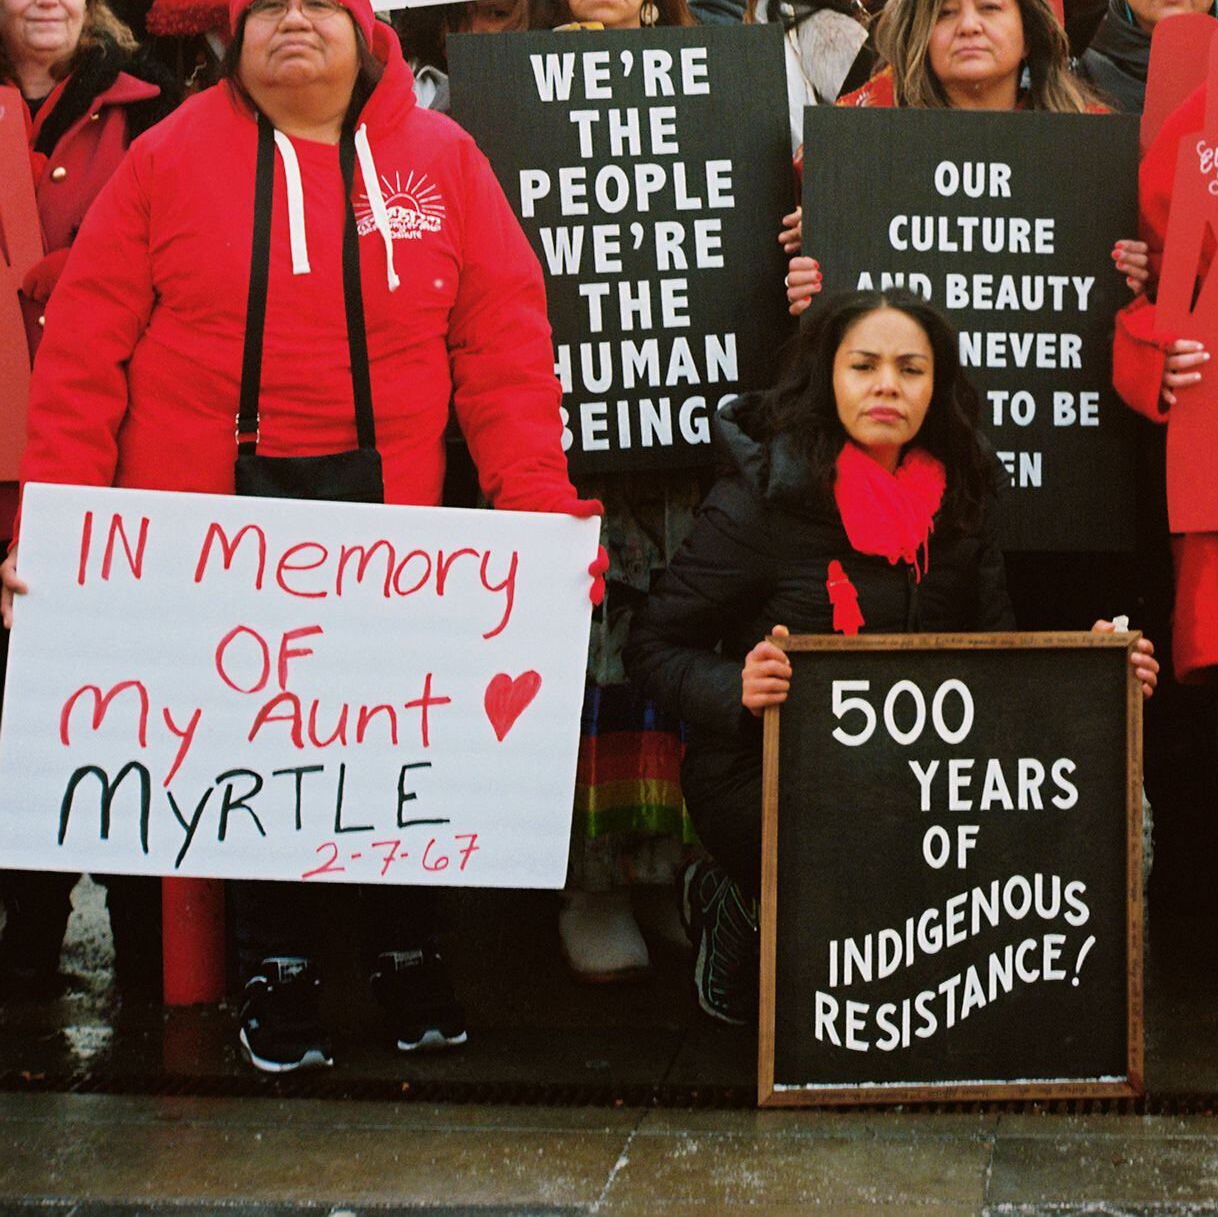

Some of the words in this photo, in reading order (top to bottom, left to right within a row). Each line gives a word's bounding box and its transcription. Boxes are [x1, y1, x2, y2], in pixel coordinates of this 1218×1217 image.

[530, 47, 710, 102] WE'RE
[569, 106, 679, 158] THE
[520, 159, 735, 218] PEOPLE
[934, 160, 1012, 198] OUR
[539, 218, 724, 276] WE'RE
[888, 215, 1055, 254] CULTURE
[579, 278, 691, 333] THE
[946, 274, 1096, 312] BEAUTY
[554, 333, 739, 394] HUMAN
[959, 332, 1082, 369] NEVER
[560, 393, 741, 452] BEING
[987, 390, 1036, 427] TO
[1053, 391, 1100, 427] BE
[78, 510, 149, 585] IN
[194, 522, 519, 640] Memory
[215, 624, 324, 694] OF
[60, 680, 202, 788] My
[248, 672, 452, 749] Aunt
[832, 678, 975, 747] 500
[908, 757, 1079, 811] YEARS
[302, 833, 480, 878] 2-7-67
[922, 825, 980, 870] OF
[829, 872, 1090, 988] INDIGENOUS
[814, 934, 1096, 1052] RESISTANCE!
